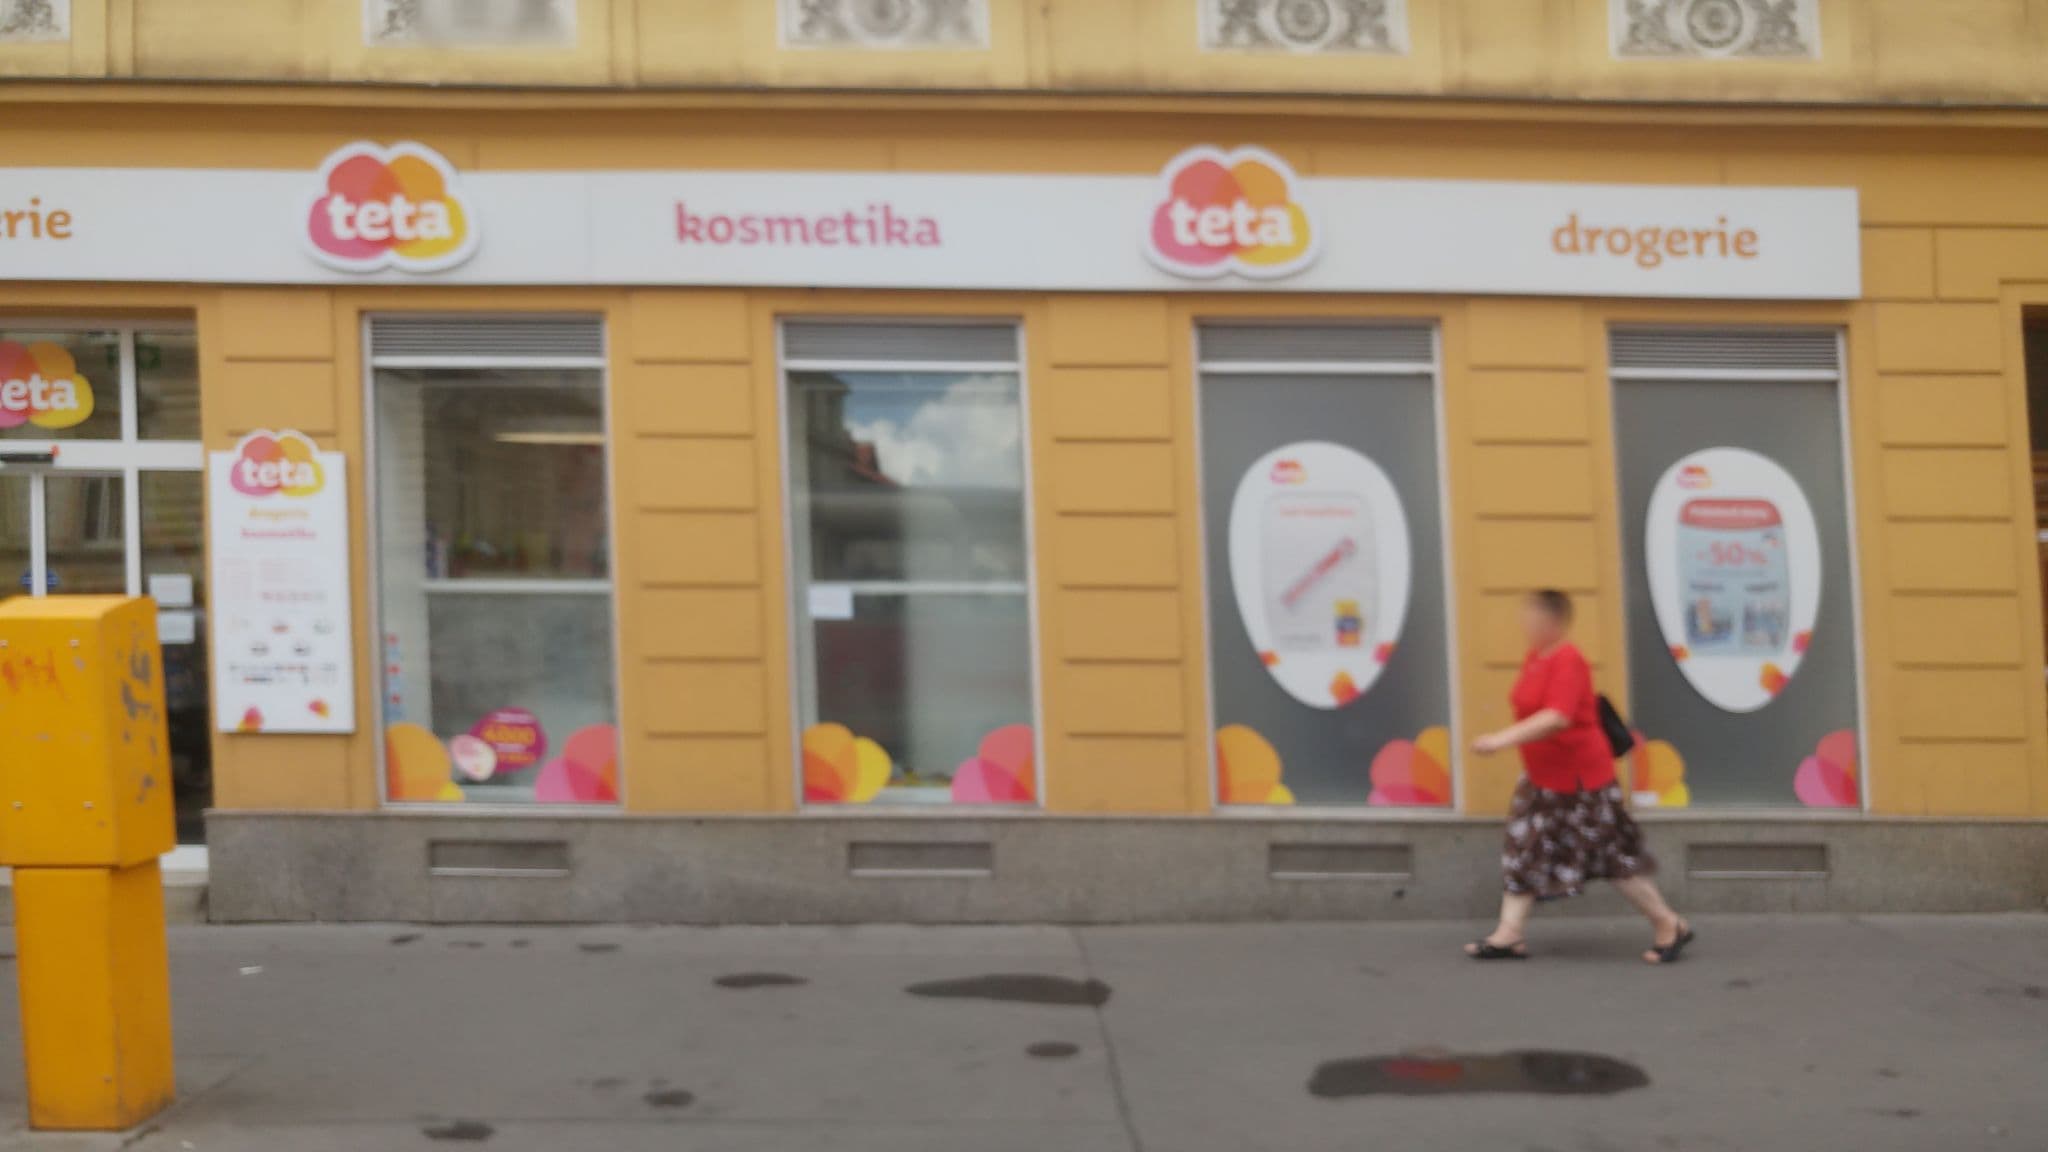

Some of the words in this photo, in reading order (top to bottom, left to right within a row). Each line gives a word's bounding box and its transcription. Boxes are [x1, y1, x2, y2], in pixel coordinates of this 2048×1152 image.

[0, 197, 73, 239] rie
[328, 194, 453, 241] teta
[675, 202, 941, 246] kosmetika
[1169, 199, 1294, 246] teta
[1552, 211, 1760, 270] drogerie
[0, 373, 79, 411] eta
[242, 458, 316, 487] teta
